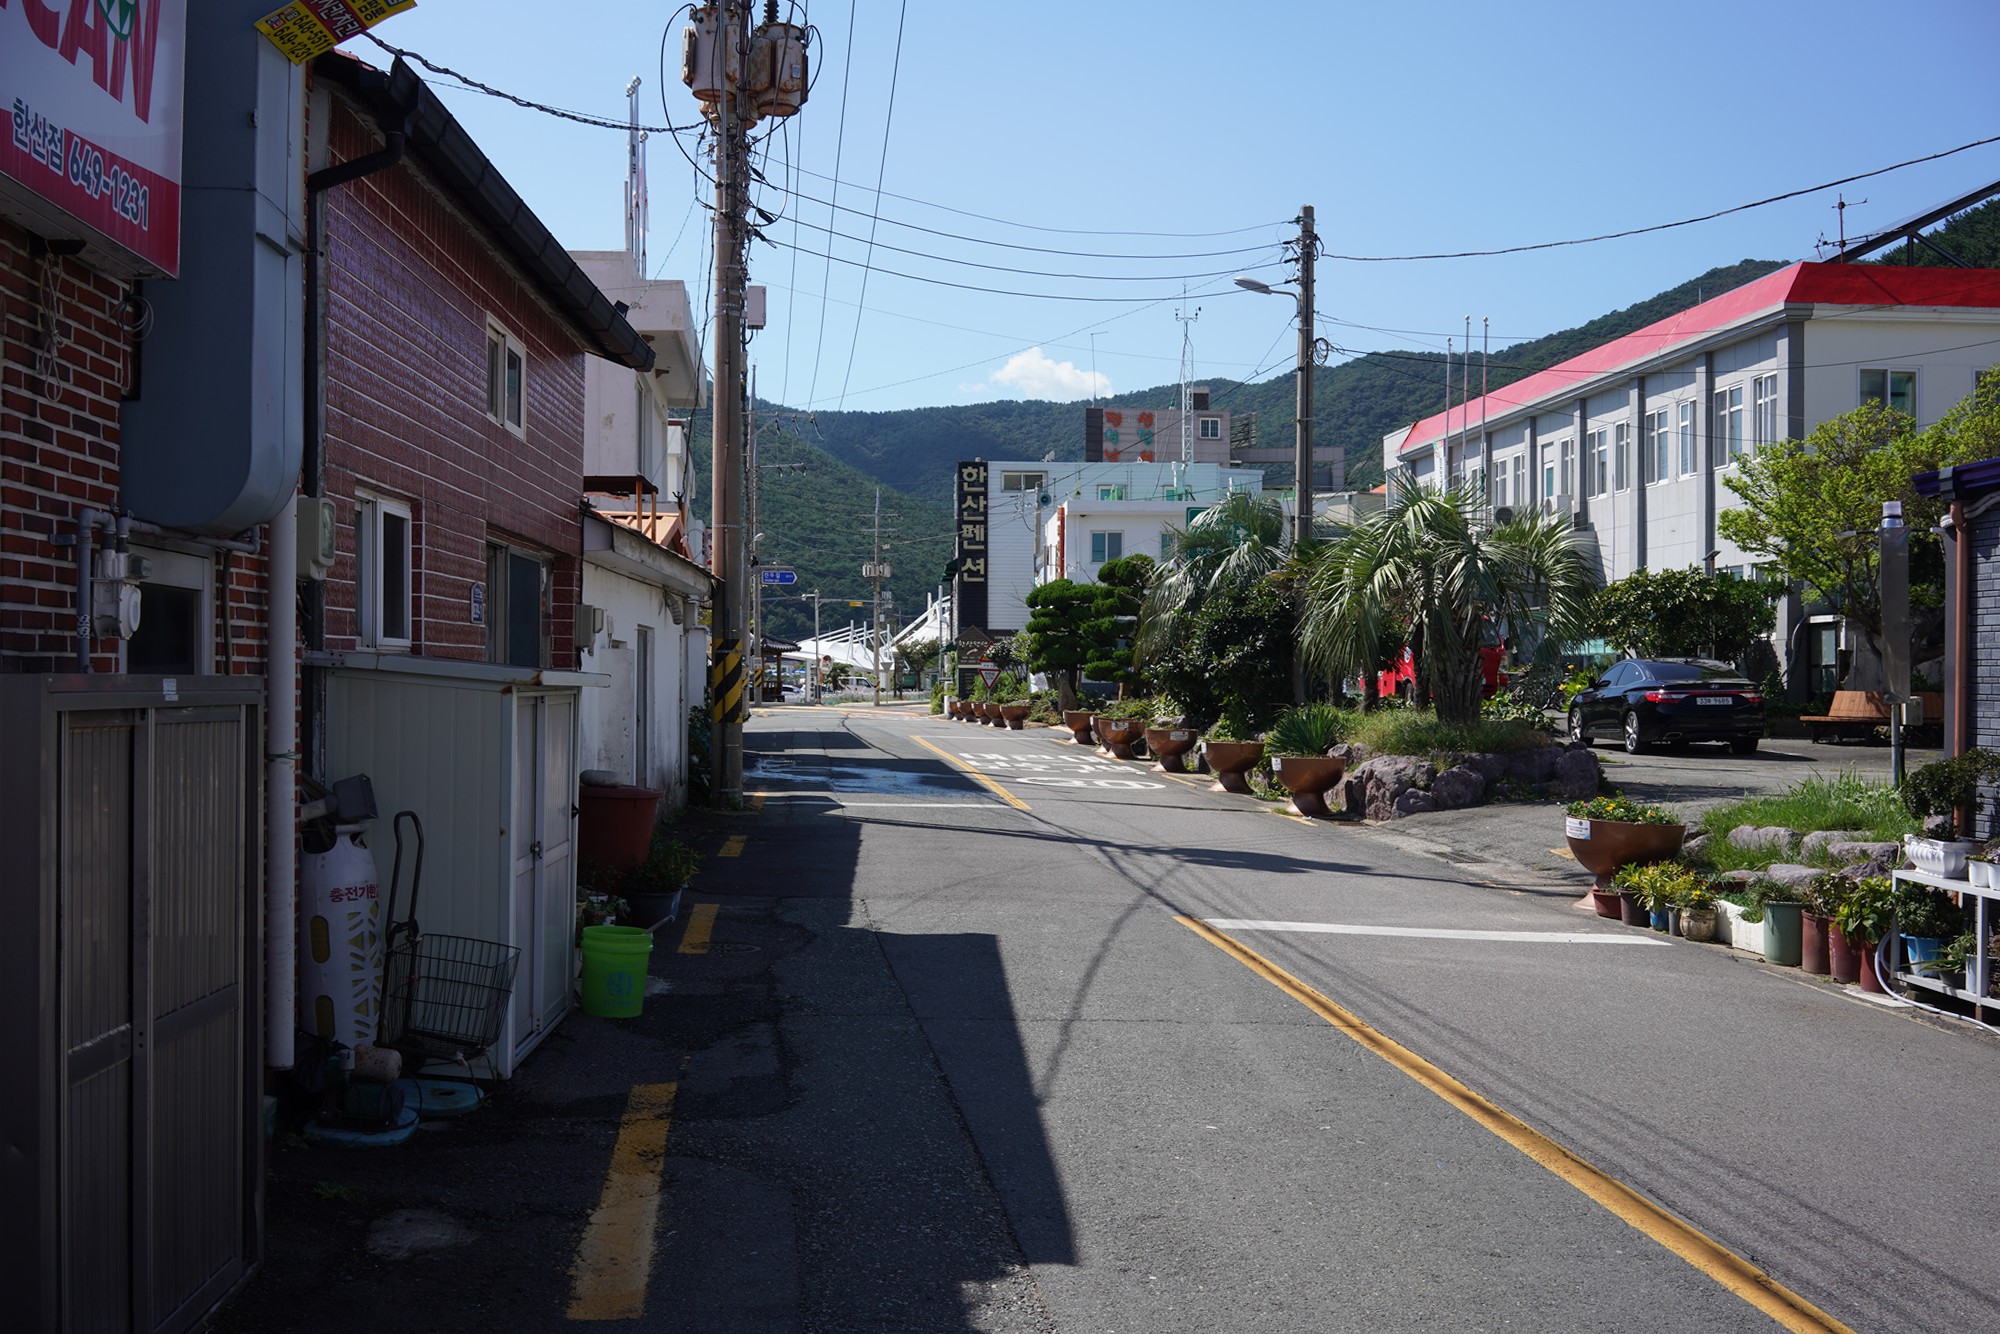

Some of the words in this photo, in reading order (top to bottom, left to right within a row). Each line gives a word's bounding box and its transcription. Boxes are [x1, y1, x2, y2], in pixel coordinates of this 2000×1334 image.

[273, 26, 314, 63] 649-1231
[293, 14, 334, 52] 648-5511
[12, 96, 64, 176] 한산점
[67, 136, 149, 231] 649-1231
[961, 466, 987, 582] 한산펜션
